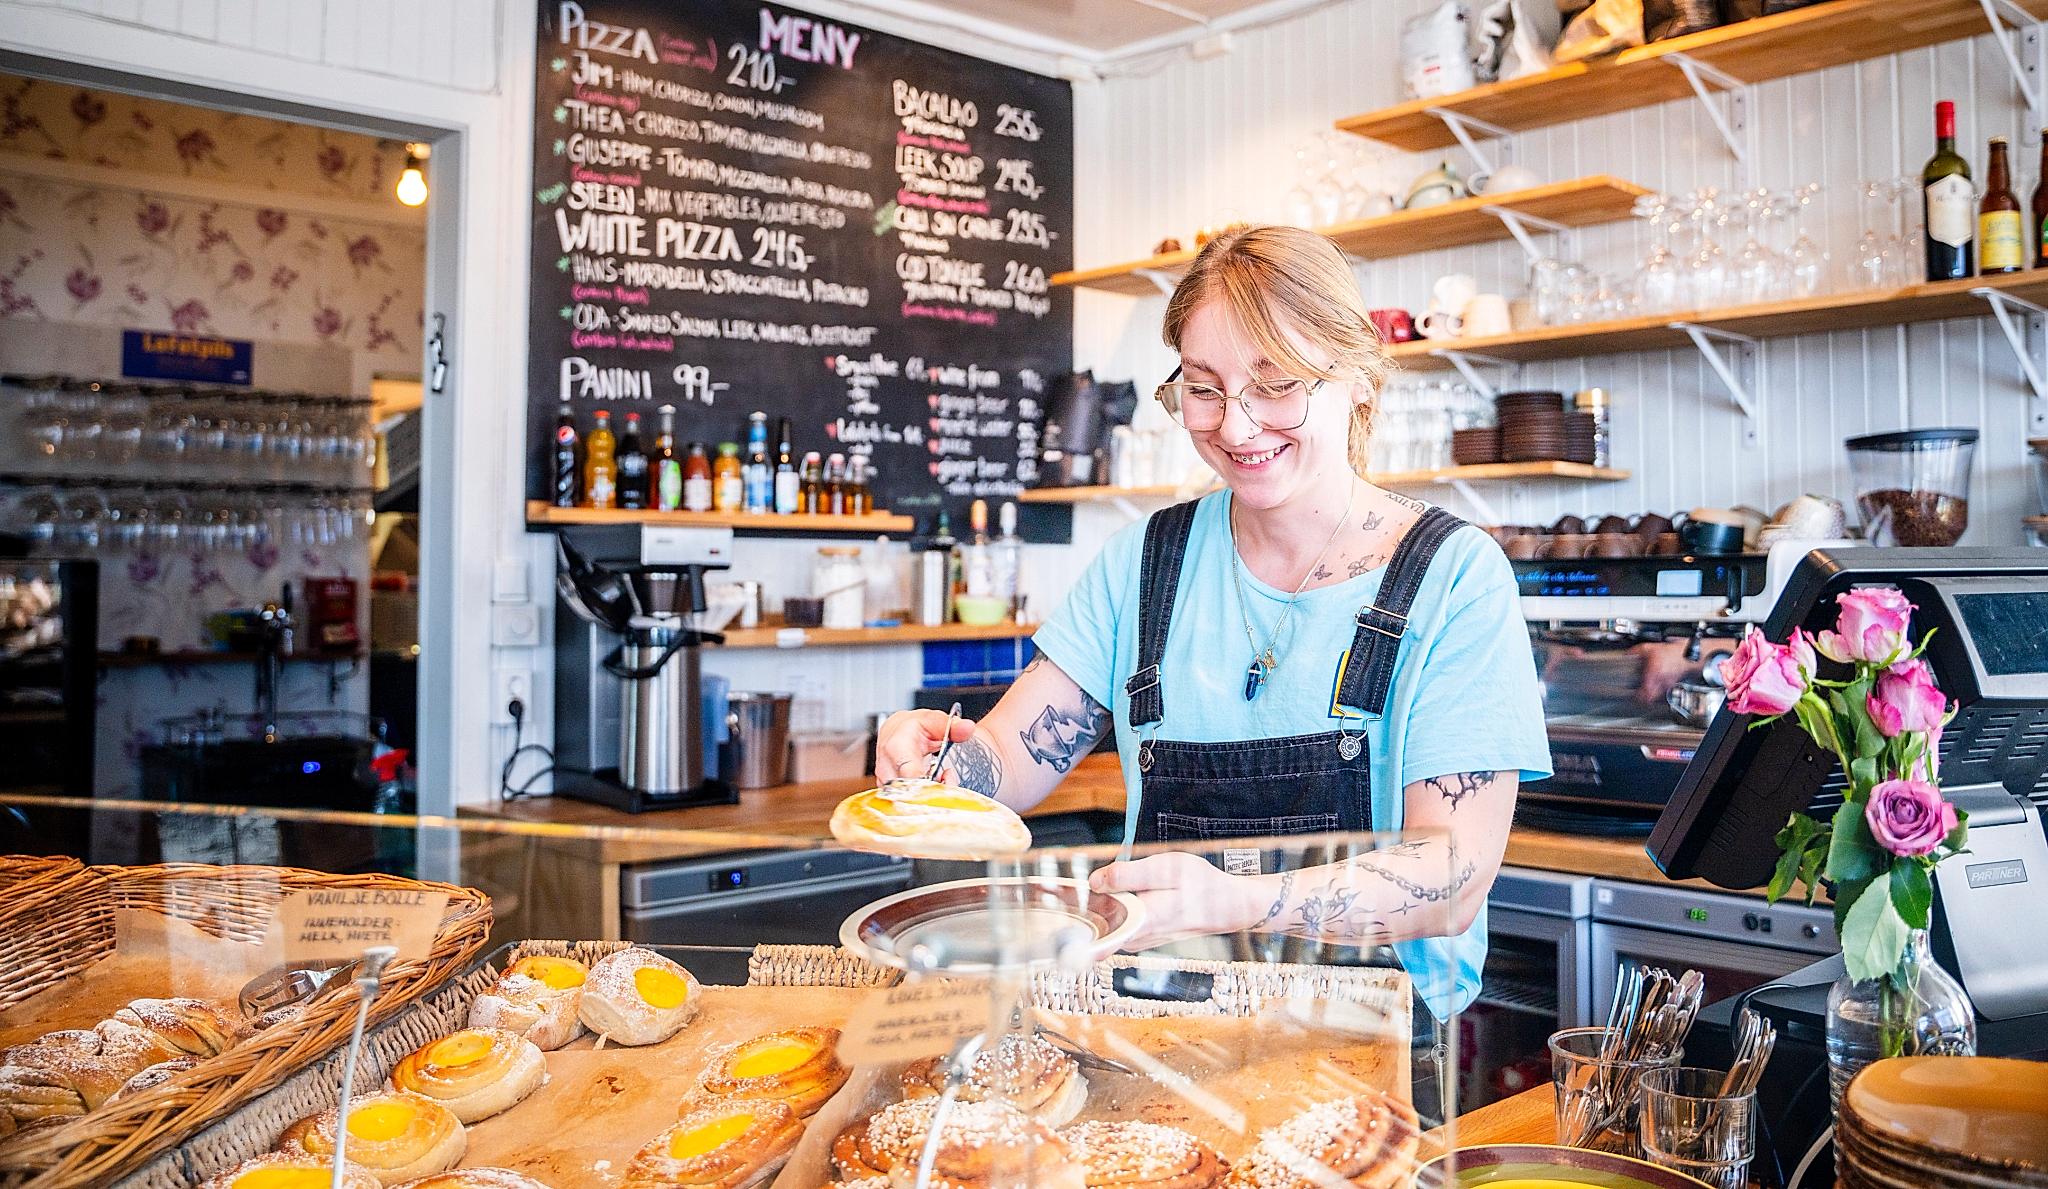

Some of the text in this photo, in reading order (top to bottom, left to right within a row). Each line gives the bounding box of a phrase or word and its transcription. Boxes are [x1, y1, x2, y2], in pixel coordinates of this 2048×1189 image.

[559, 1, 659, 64] PIZZA
[759, 8, 861, 70] MENY
[571, 51, 614, 88] JIM
[726, 43, 797, 94] 210,-
[563, 99, 626, 136] THEA
[893, 79, 979, 127] BACALAO
[565, 132, 651, 170] GIUSEPPE
[895, 145, 984, 183] LEEK SOUP
[567, 181, 635, 215] STEEN
[555, 208, 651, 256] WHITE
[656, 217, 743, 261] PIZZA
[571, 253, 618, 283] HANS
[573, 302, 611, 331] ODA
[560, 356, 652, 401] PANINI
[1971, 866, 2022, 881] PARTNER
